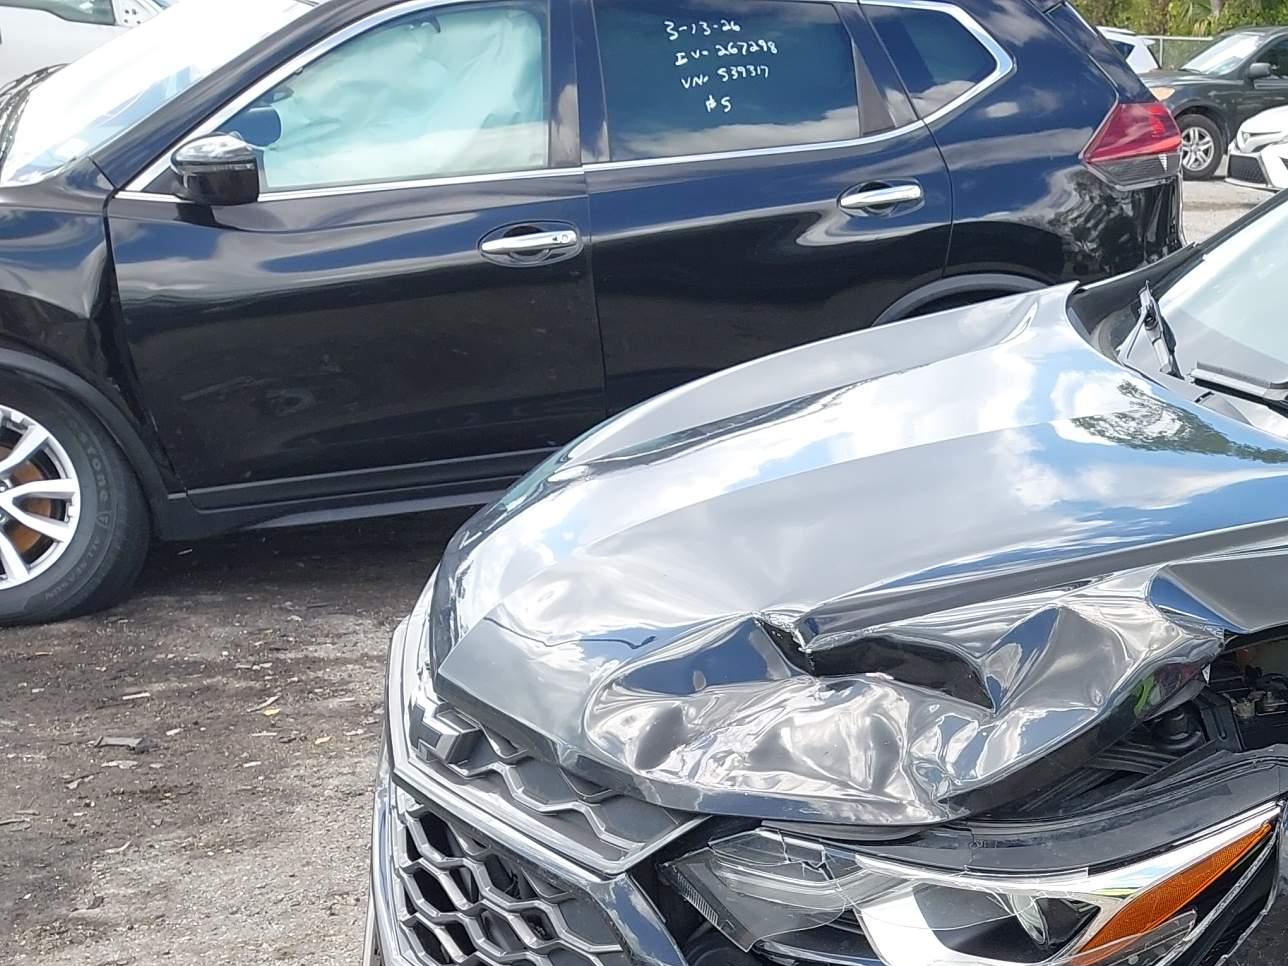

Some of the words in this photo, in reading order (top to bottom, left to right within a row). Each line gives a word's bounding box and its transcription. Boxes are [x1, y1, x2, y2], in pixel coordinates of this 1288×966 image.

[664, 20, 740, 40] 3-13-26
[715, 39, 778, 56] 267298
[717, 65, 769, 82] 539317
